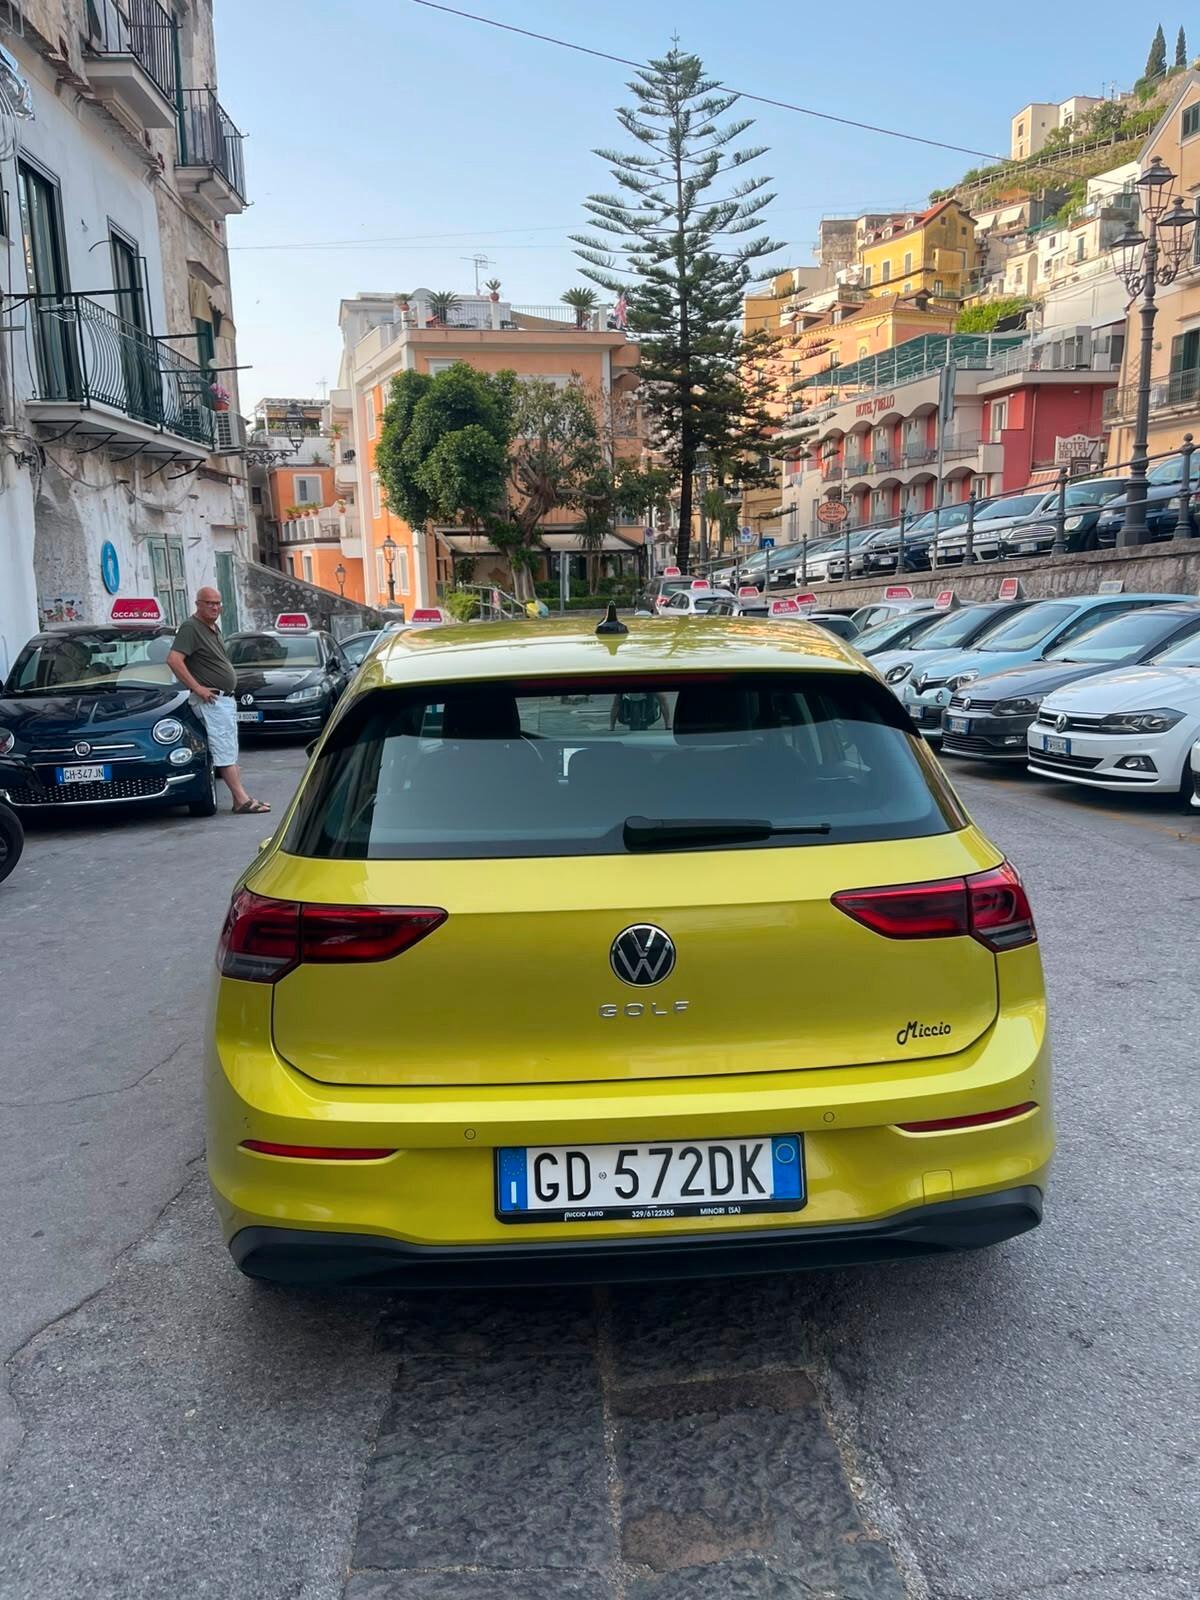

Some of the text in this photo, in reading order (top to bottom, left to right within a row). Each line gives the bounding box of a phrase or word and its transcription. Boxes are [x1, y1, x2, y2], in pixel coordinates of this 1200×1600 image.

[855, 401, 873, 418] HOTEL
[1058, 441, 1089, 450] HOTEL
[599, 1000, 690, 1018] GOLF
[896, 1020, 952, 1045] Miccio
[533, 1143, 767, 1202] GD 572DK
[631, 1209, 675, 1218] 329/6122355
[700, 1207, 725, 1215] MINORI
